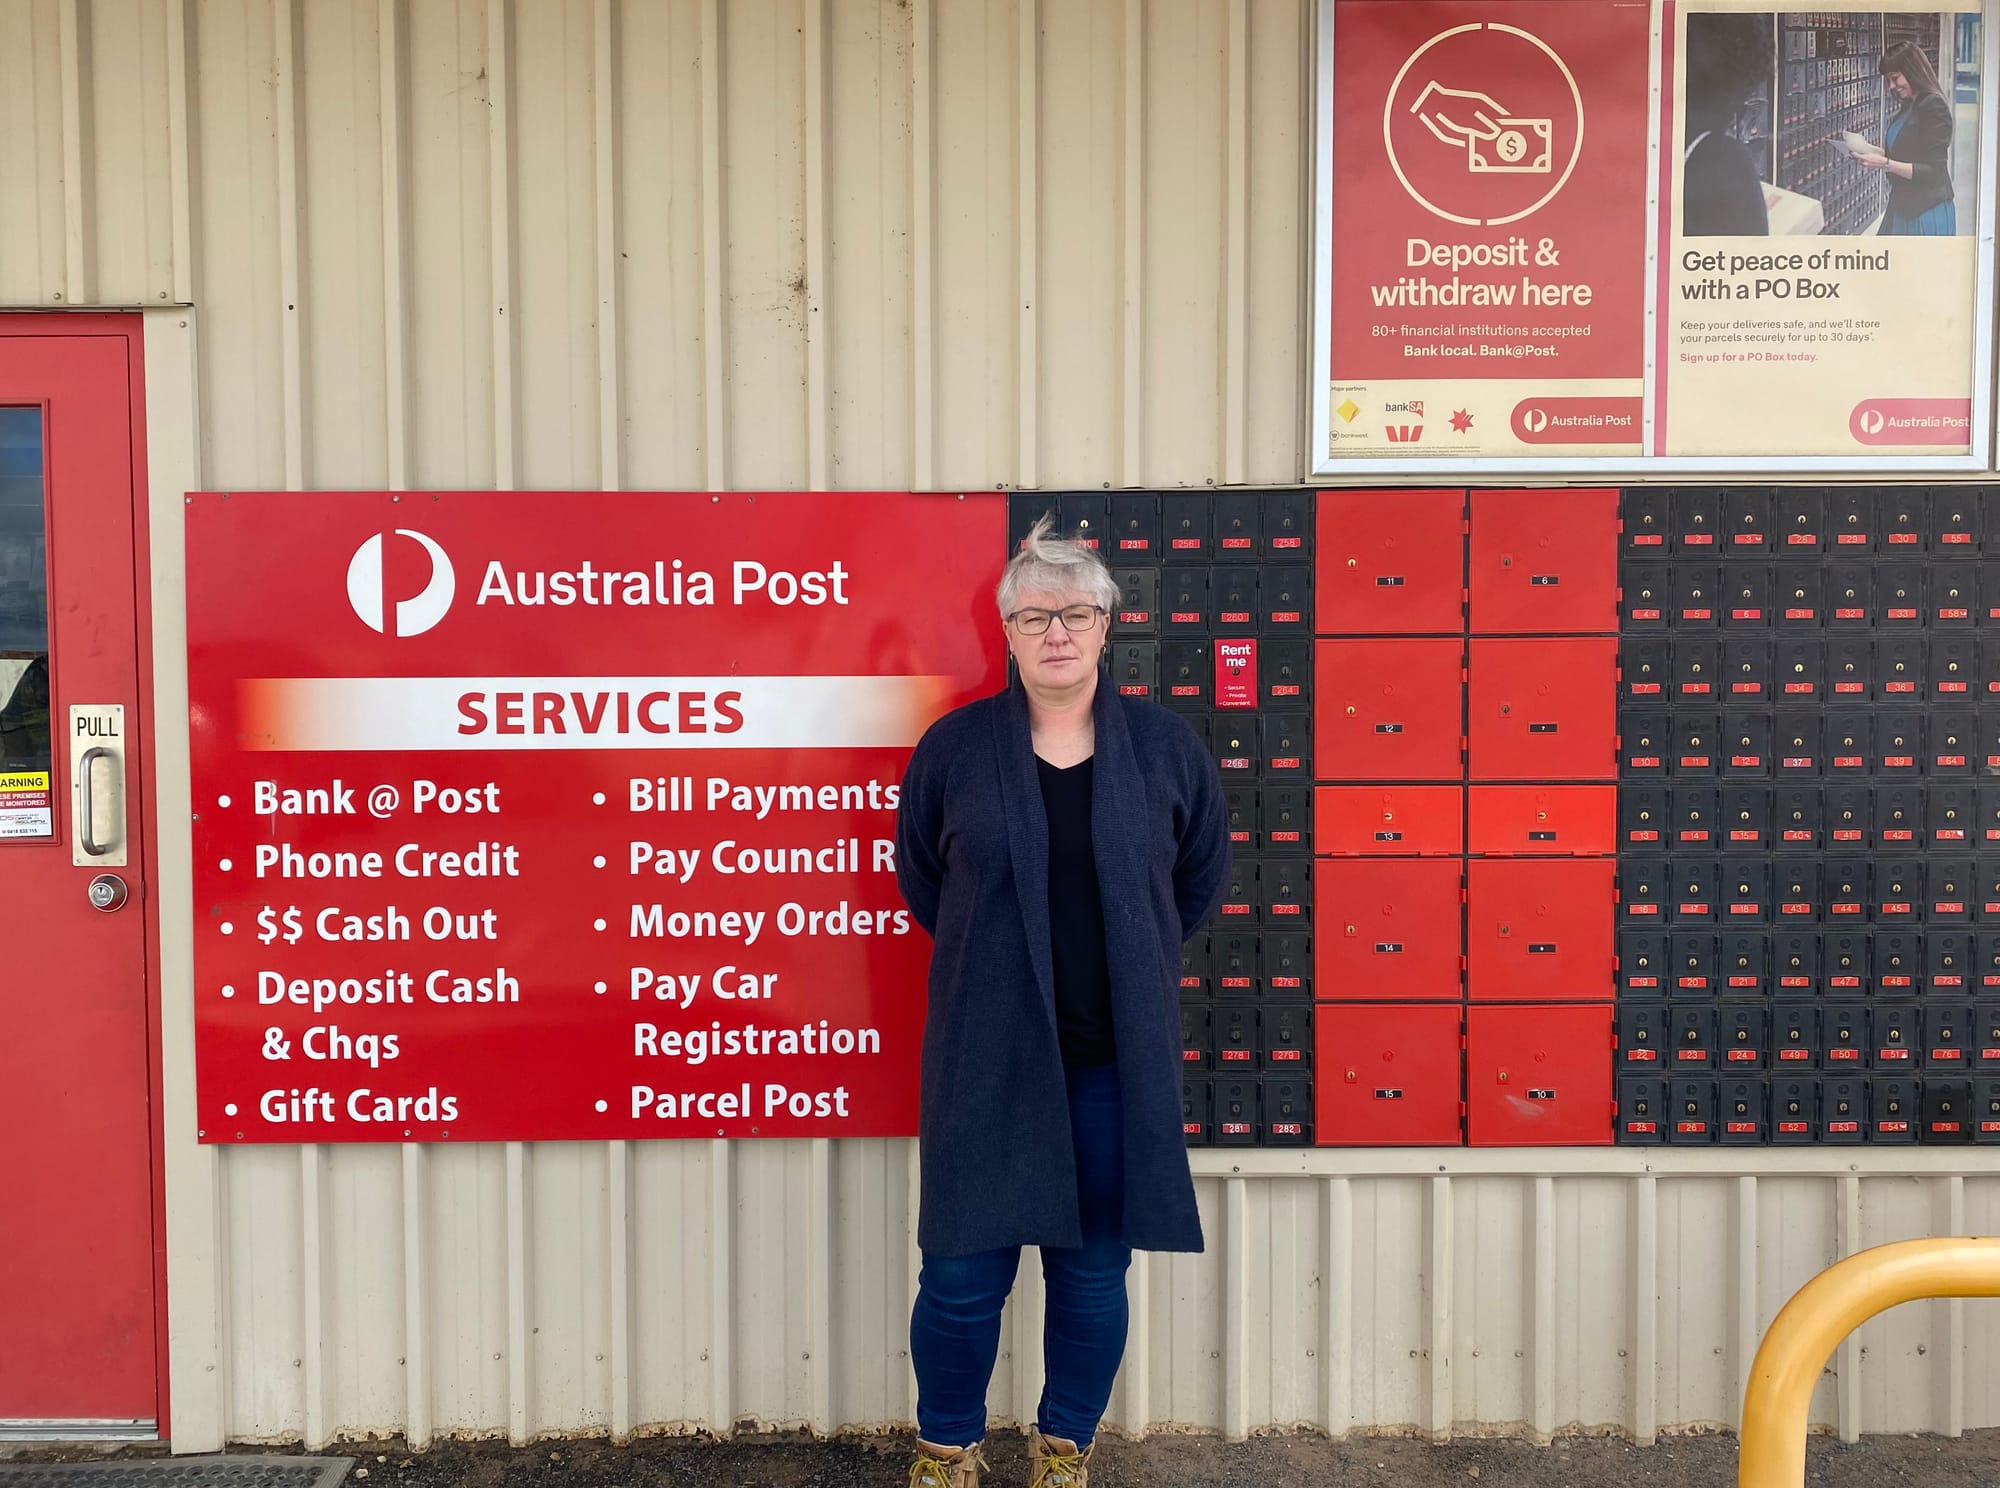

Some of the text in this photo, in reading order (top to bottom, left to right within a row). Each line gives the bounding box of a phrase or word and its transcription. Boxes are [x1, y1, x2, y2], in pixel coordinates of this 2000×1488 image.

[1407, 236, 1560, 272] Deposit &
[1682, 250, 1890, 275] Get peace of mind
[1371, 276, 1592, 307] withdraw here
[1681, 278, 1840, 300] with a PO Box
[1680, 320, 1706, 331] Keep
[1708, 322, 1730, 331] your
[1733, 320, 1781, 329] deliveries
[1784, 319, 1806, 330] safe,
[1808, 320, 1826, 328] and
[1856, 320, 1880, 328] store
[1371, 324, 1591, 339] 80+ financial institutions accepted
[1680, 334, 1702, 344] your
[1704, 333, 1742, 344] parcels
[1744, 332, 1785, 344] securely
[1788, 332, 1801, 342] for
[1804, 334, 1816, 344] up
[1818, 333, 1829, 342] to
[1831, 332, 1843, 342] 30
[1404, 344, 1560, 358] Bank local. Bank@Post.
[1680, 352, 1703, 364] Sign
[1706, 354, 1719, 364] up
[1722, 352, 1736, 362] for
[1748, 352, 1762, 361] PO
[1766, 352, 1784, 361] Box
[1787, 352, 1818, 364] today.
[1386, 400, 1424, 412] bankSA
[1551, 415, 1631, 426] Australia Post
[1888, 417, 1970, 428] Australia Post
[476, 560, 848, 606] Australia Post
[1542, 577, 1548, 585] 6
[1127, 613, 1143, 621] 234
[1222, 645, 1251, 656] Rent
[1226, 658, 1246, 666] me
[1795, 684, 1805, 692] 34
[458, 691, 744, 735] SERVICES
[76, 717, 118, 737] PULL
[1386, 725, 1394, 733] 12
[1228, 759, 1242, 767] 266
[1641, 758, 1650, 766] 10
[1742, 757, 1752, 765] 12
[0, 778, 43, 788] ARNING
[254, 780, 500, 818] Bank @ Post
[629, 777, 901, 820] Bill Payments
[1384, 832, 1393, 840] 13
[1640, 832, 1648, 840] 13
[1893, 831, 1903, 839] 42
[256, 842, 519, 878] Phone Credit
[630, 841, 700, 883] Pay
[712, 839, 858, 874] Council
[256, 905, 497, 945] $$ Cash Out
[630, 901, 910, 945] Money Orders
[1384, 944, 1394, 952] 14
[631, 966, 778, 1009] Pay Car
[1687, 978, 1698, 986] 20
[258, 968, 519, 1013] Deposit Cash
[262, 1025, 400, 1068] & Chqs
[634, 1020, 880, 1064] Registration
[1636, 1051, 1647, 1059] 22
[1737, 1051, 1747, 1059] 24
[1889, 1050, 1900, 1058] 51
[1941, 1050, 1952, 1058] 76
[1385, 1090, 1393, 1098] 15
[1538, 1090, 1546, 1099] 10
[260, 1088, 459, 1122] Gift Cards
[632, 1084, 848, 1118] Parcel Post
[1229, 1124, 1243, 1132] 281
[1788, 1123, 1798, 1131] 52
